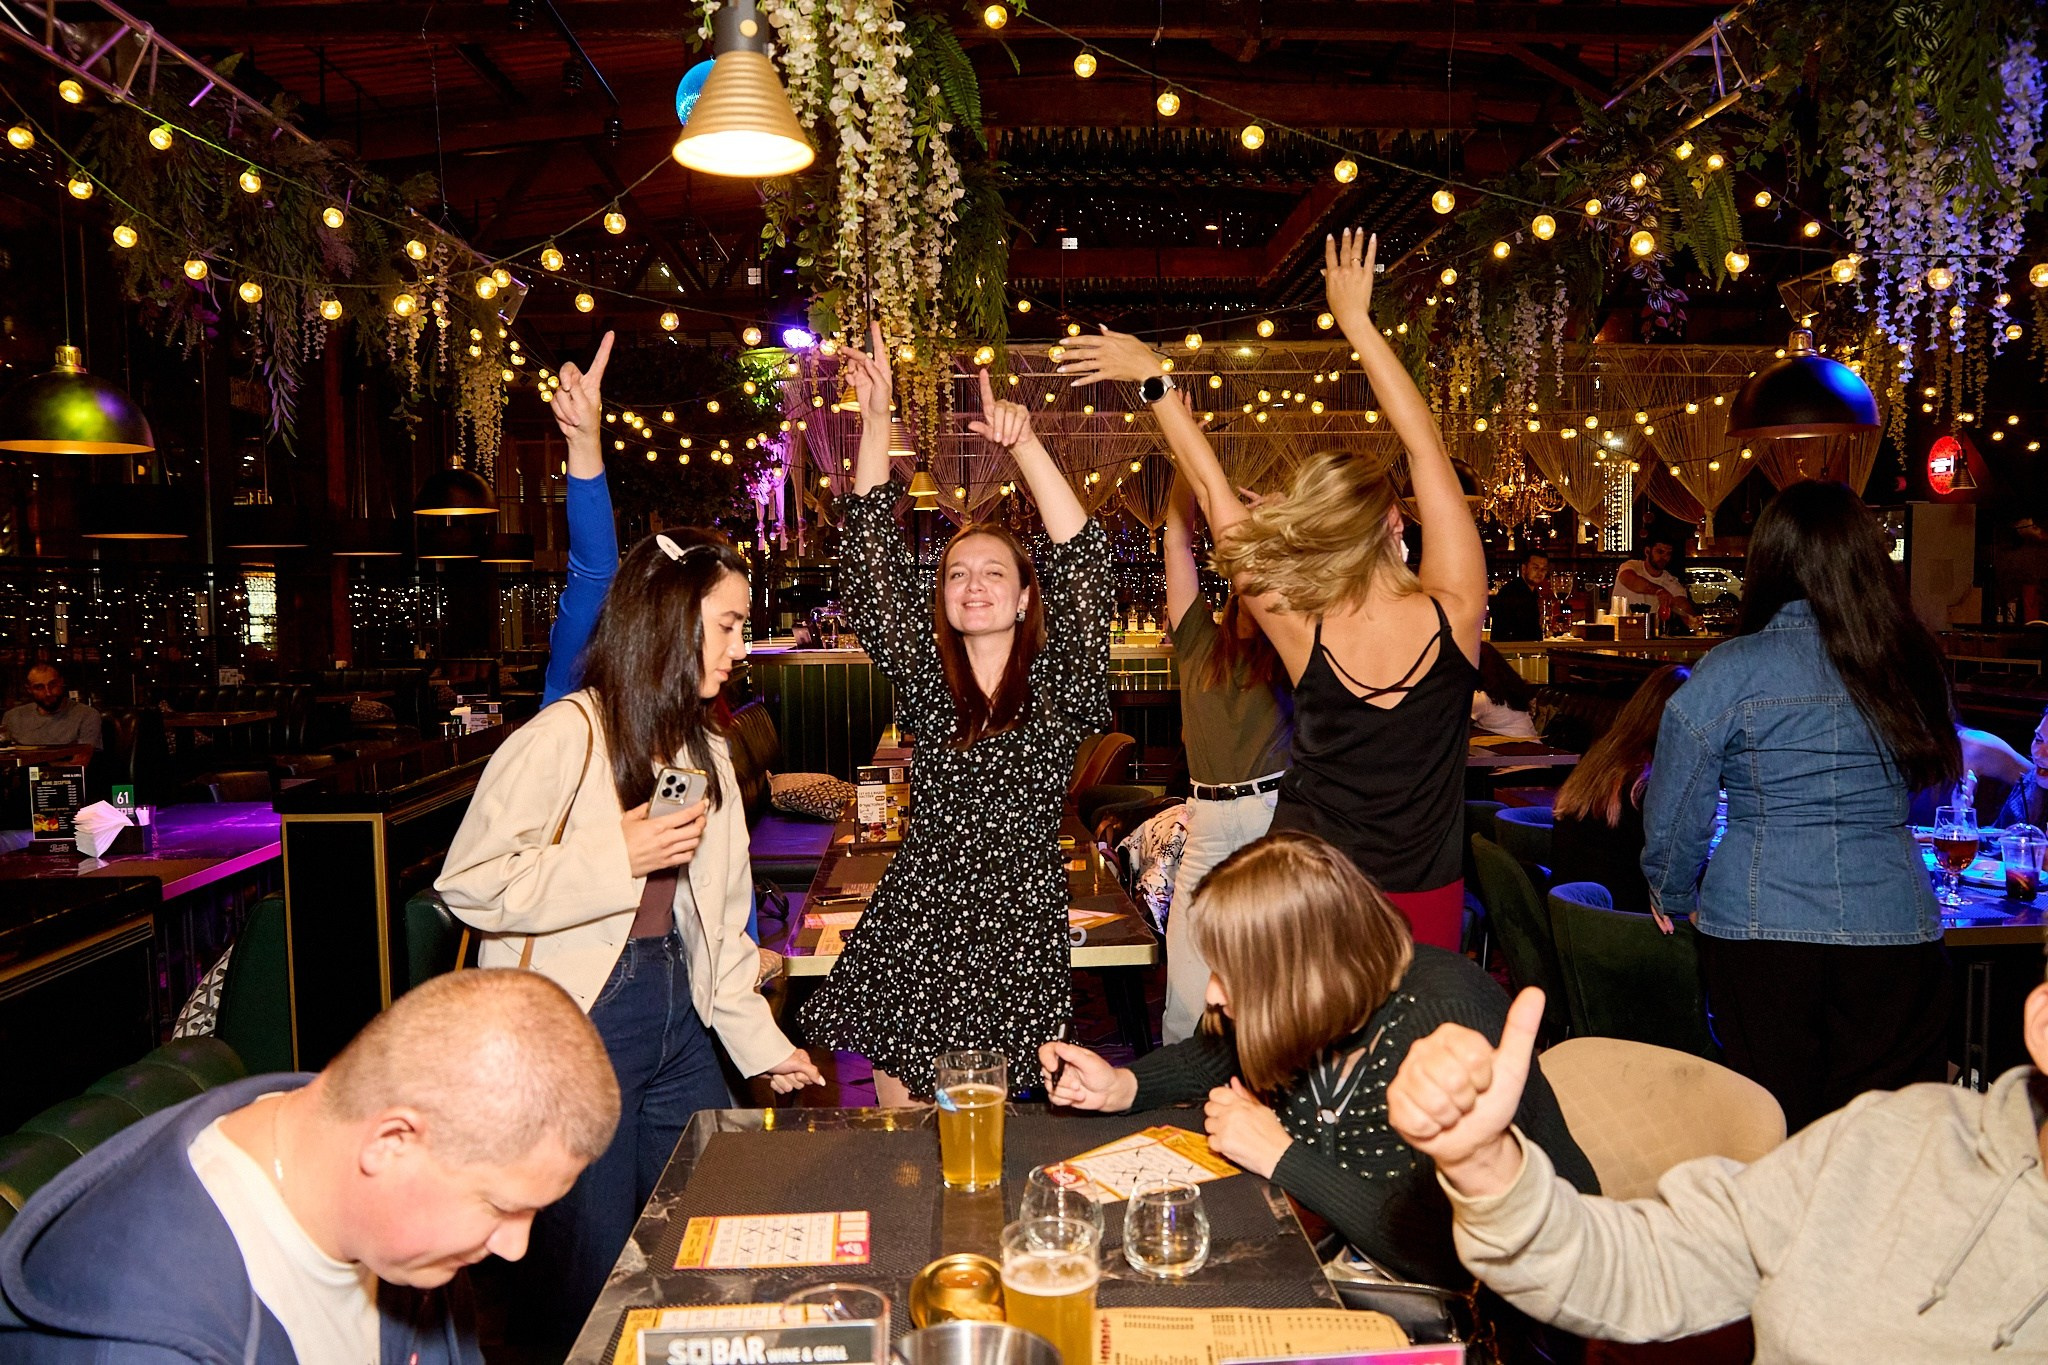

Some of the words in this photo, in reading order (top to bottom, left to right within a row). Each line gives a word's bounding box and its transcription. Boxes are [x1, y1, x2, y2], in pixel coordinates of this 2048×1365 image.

[117, 791, 129, 805] 61
[766, 1347, 801, 1364] WINE
[801, 1346, 813, 1363] &
[813, 1345, 848, 1362] GRILL
